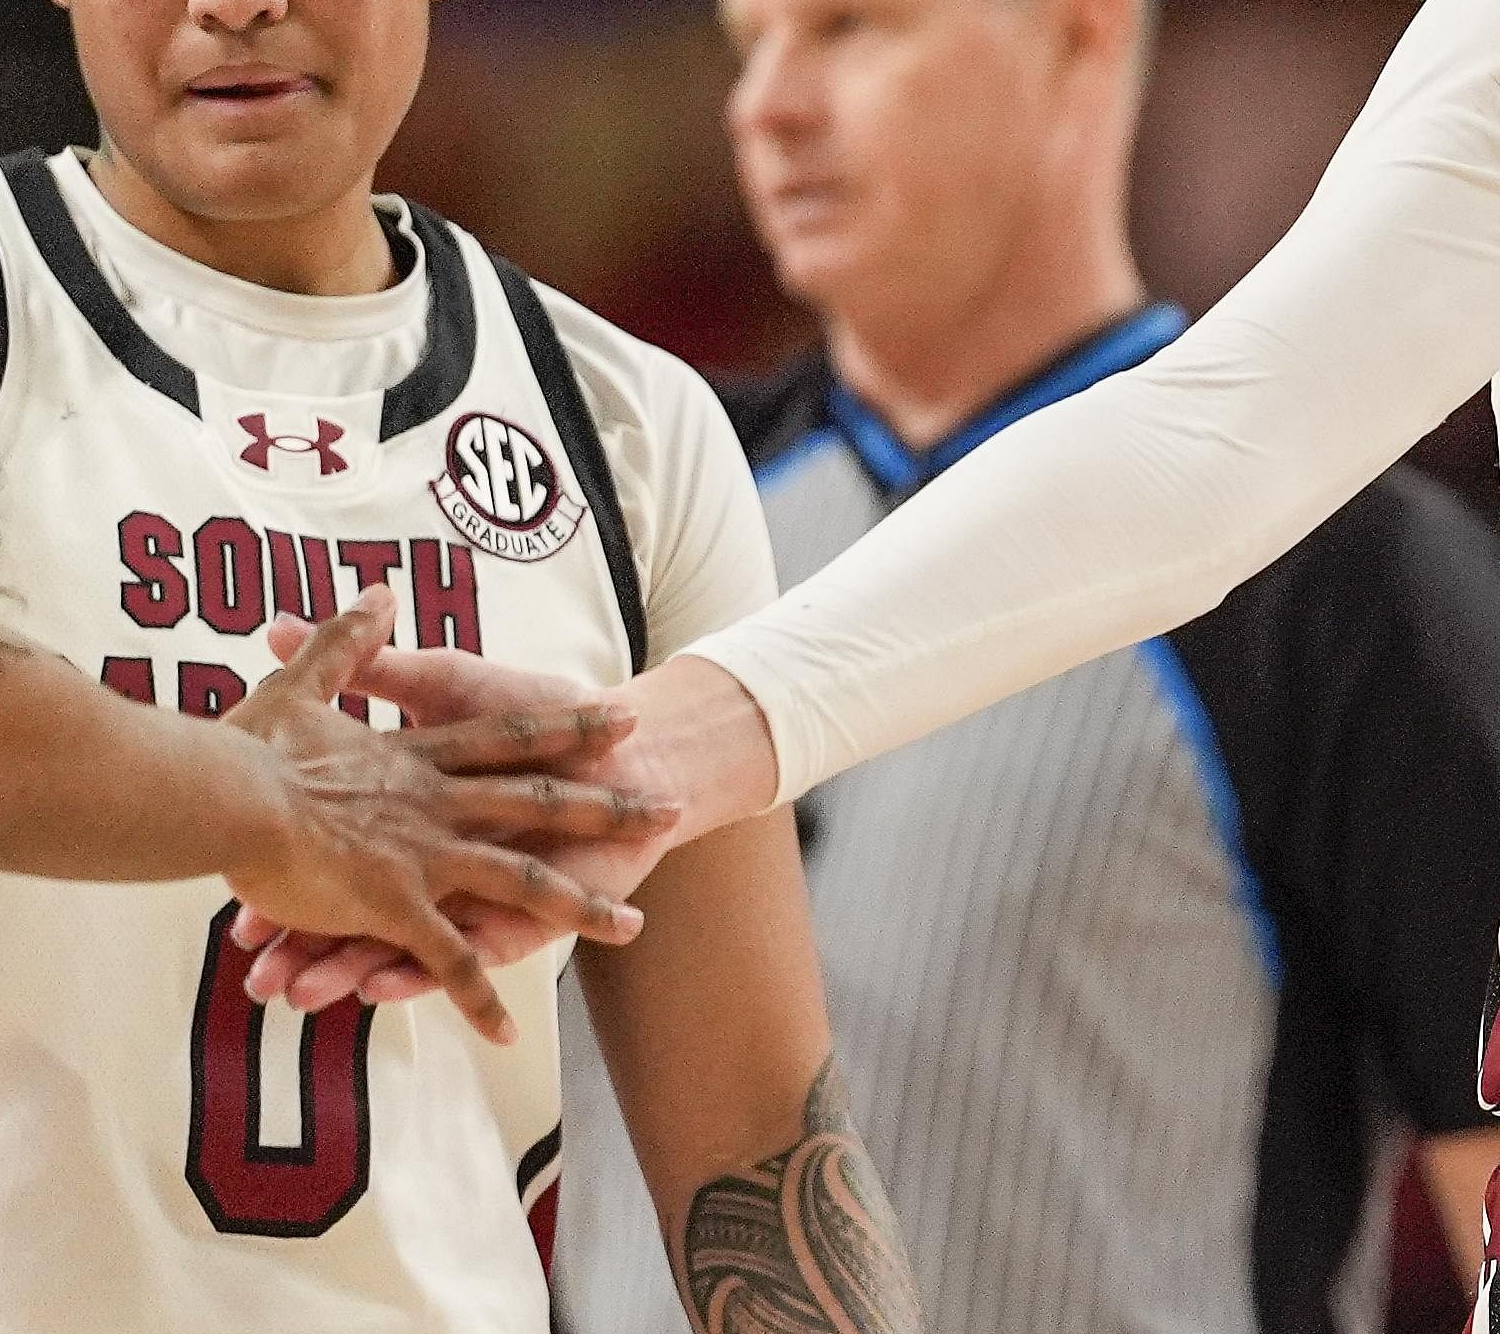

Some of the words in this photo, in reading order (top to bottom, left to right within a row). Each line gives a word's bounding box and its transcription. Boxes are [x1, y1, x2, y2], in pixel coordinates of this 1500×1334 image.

[455, 417, 548, 522] SEC
[452, 501, 565, 556] GRADUATE
[118, 510, 484, 655] SOUTH
